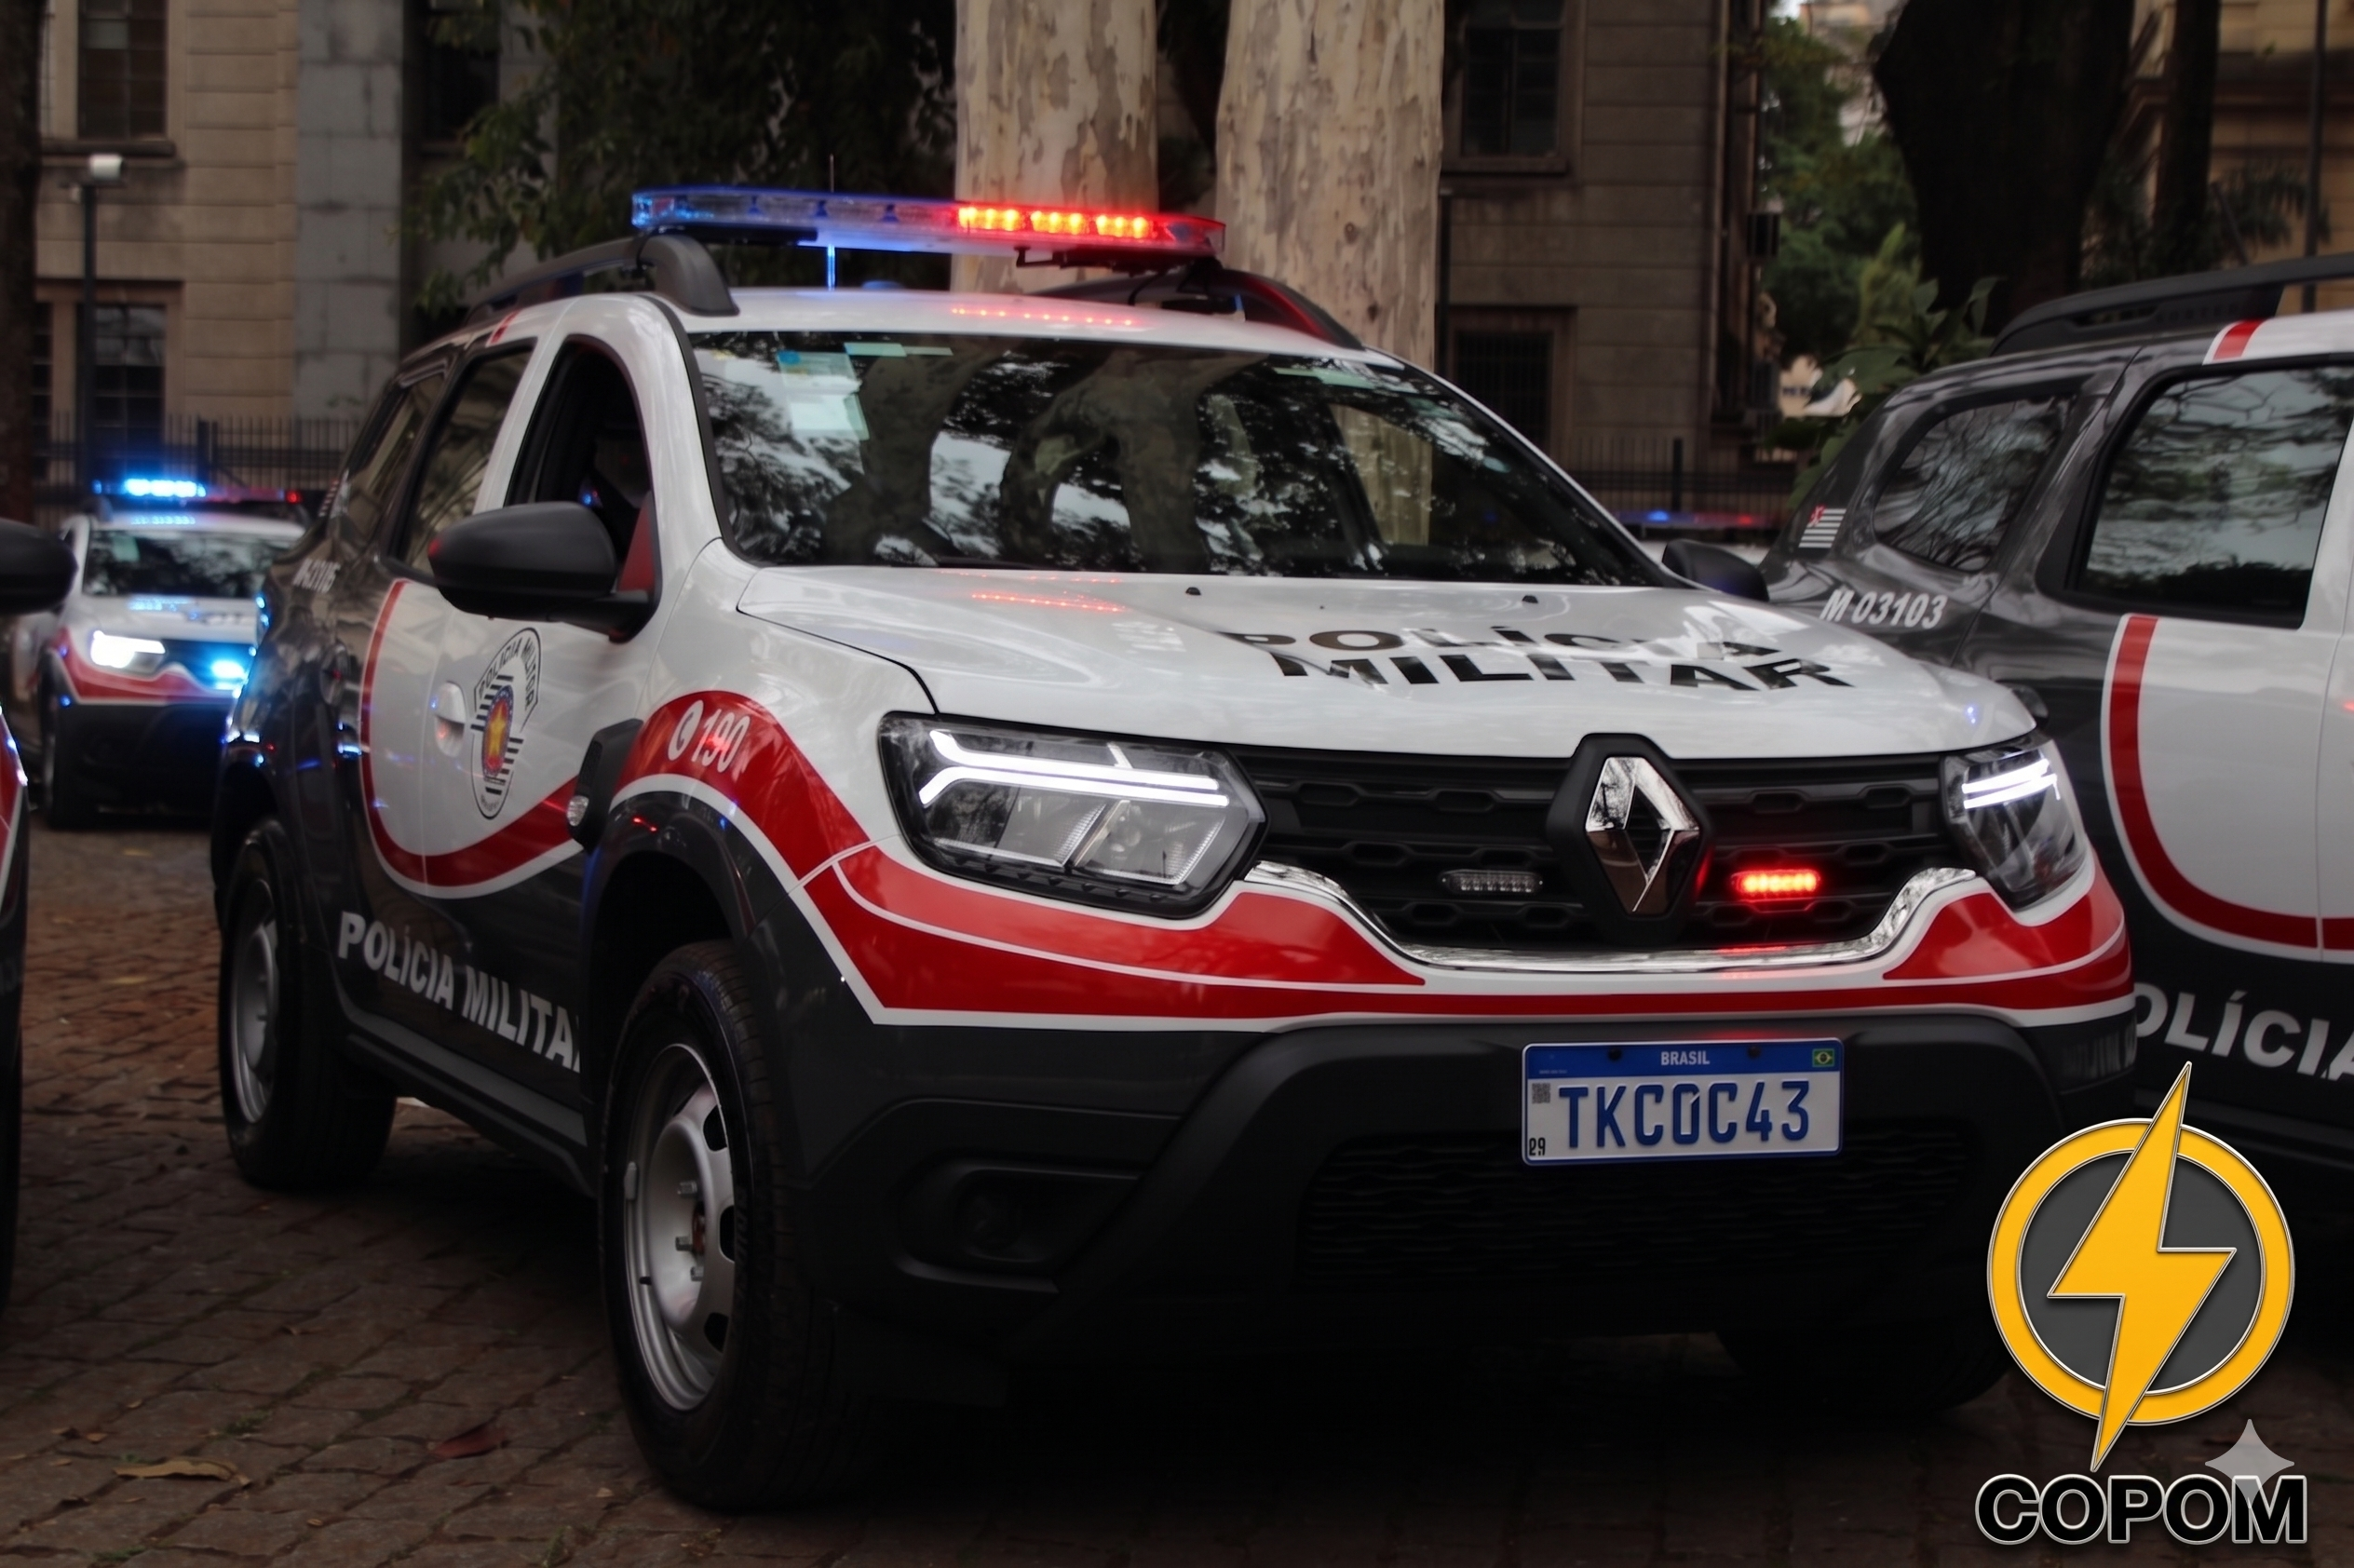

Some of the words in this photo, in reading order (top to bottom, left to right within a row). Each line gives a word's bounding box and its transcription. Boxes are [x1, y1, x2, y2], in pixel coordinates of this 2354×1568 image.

[1820, 588, 1855, 622] M
[1851, 591, 1947, 629] 03103
[1269, 652, 1856, 691] MILITAR
[691, 709, 751, 773] 190
[338, 911, 453, 1010] POLÍCIA
[462, 965, 581, 1074] MILITA
[1660, 1049, 1711, 1066] BRASIL
